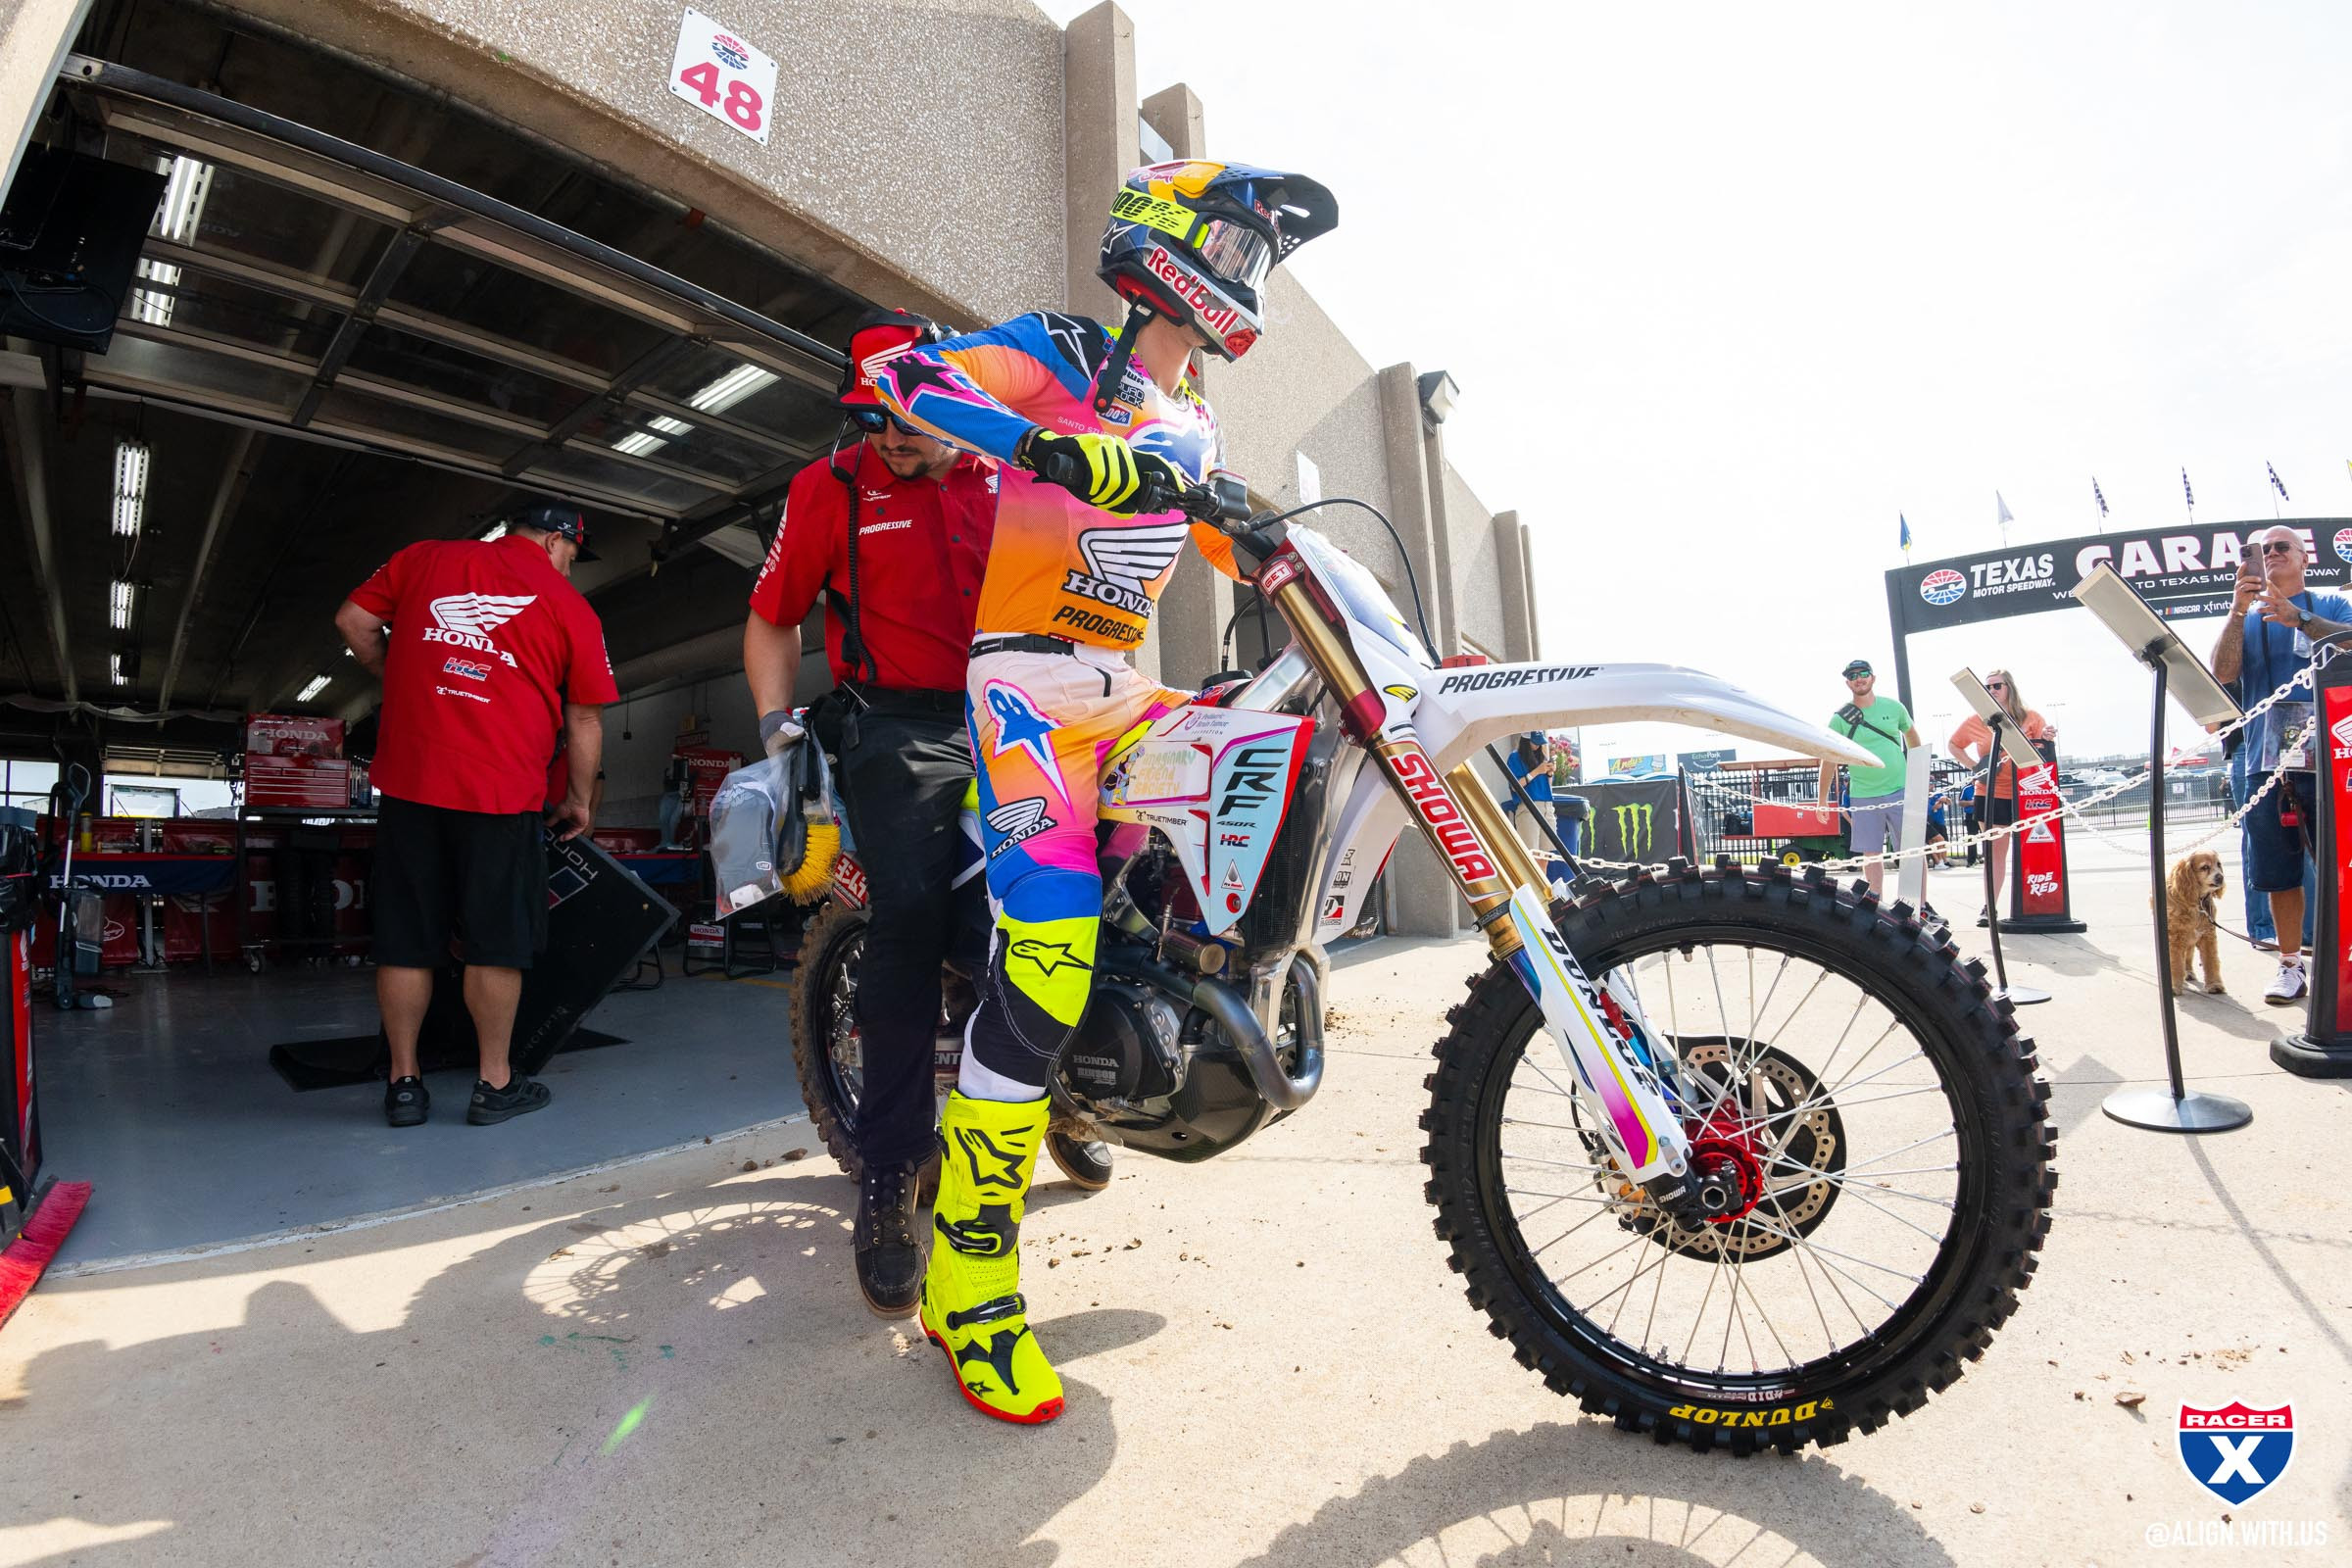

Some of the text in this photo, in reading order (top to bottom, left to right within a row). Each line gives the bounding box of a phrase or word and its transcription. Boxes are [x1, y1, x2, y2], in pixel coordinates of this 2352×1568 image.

[680, 62, 762, 131] 48
[1146, 245, 1241, 337] Red Bull
[1057, 416, 1085, 432] SANTO
[1103, 409, 1128, 422] 00%
[858, 519, 912, 536] PROGRESSIVE
[2076, 528, 2319, 580] GARAE
[1970, 554, 2054, 588] TEXAS
[2135, 580, 2156, 589] TO
[2159, 575, 2210, 586] TEXAS
[1063, 570, 1153, 618] HONDA
[1973, 585, 2005, 599] MOTOR
[2175, 605, 2201, 614] NASCAR
[1439, 666, 1600, 695] PROGRESSIVE
[1217, 748, 1289, 817] CRF
[1146, 813, 1188, 826] TRUETIMBER
[1390, 753, 1496, 883] SHOWA
[991, 815, 1058, 859] HONDA
[1220, 834, 1250, 848] HRC
[2027, 871, 2054, 885] RIDE
[2031, 881, 2058, 897] RED
[1073, 1054, 1120, 1068] HONDA
[1658, 1185, 1687, 1203] SHOWA
[1669, 1400, 1818, 1428] DUNLOP
